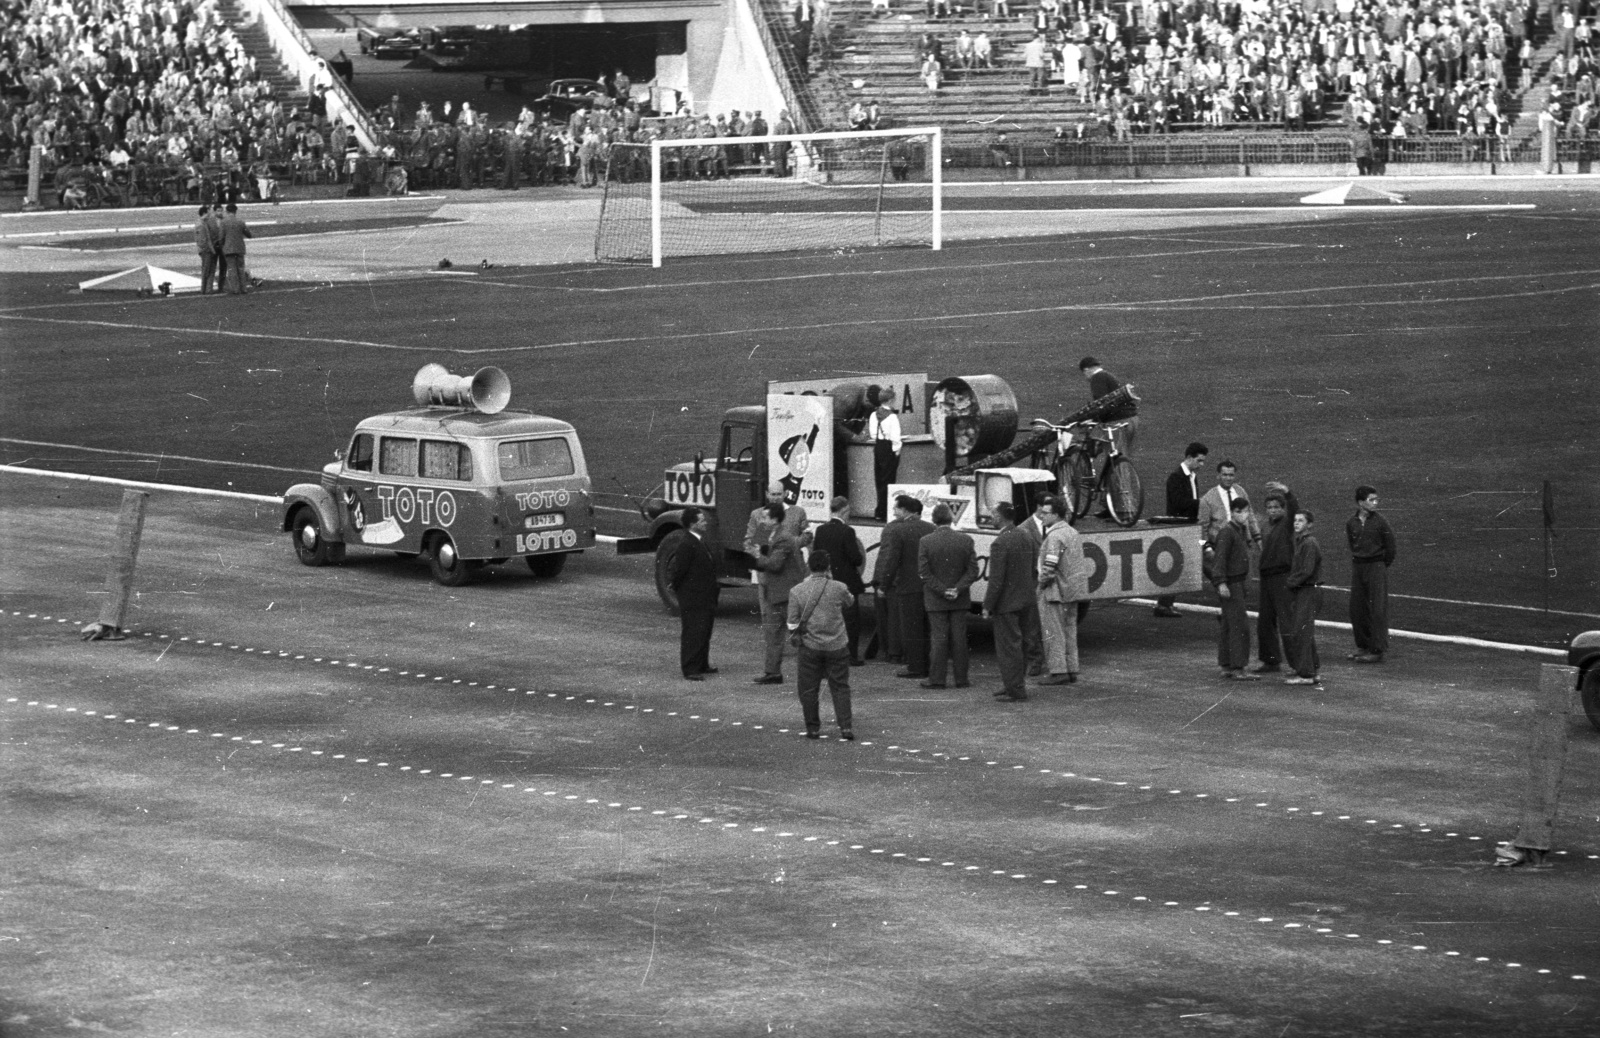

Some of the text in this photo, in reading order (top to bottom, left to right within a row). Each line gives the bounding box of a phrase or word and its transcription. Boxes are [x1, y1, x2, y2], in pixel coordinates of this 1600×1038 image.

[515, 488, 570, 511] TOTO
[665, 471, 714, 505] TOTO
[801, 489, 825, 500] TOTO
[378, 485, 457, 528] TOTO
[516, 528, 577, 553] LOTTO
[1082, 536, 1185, 594] OTO
